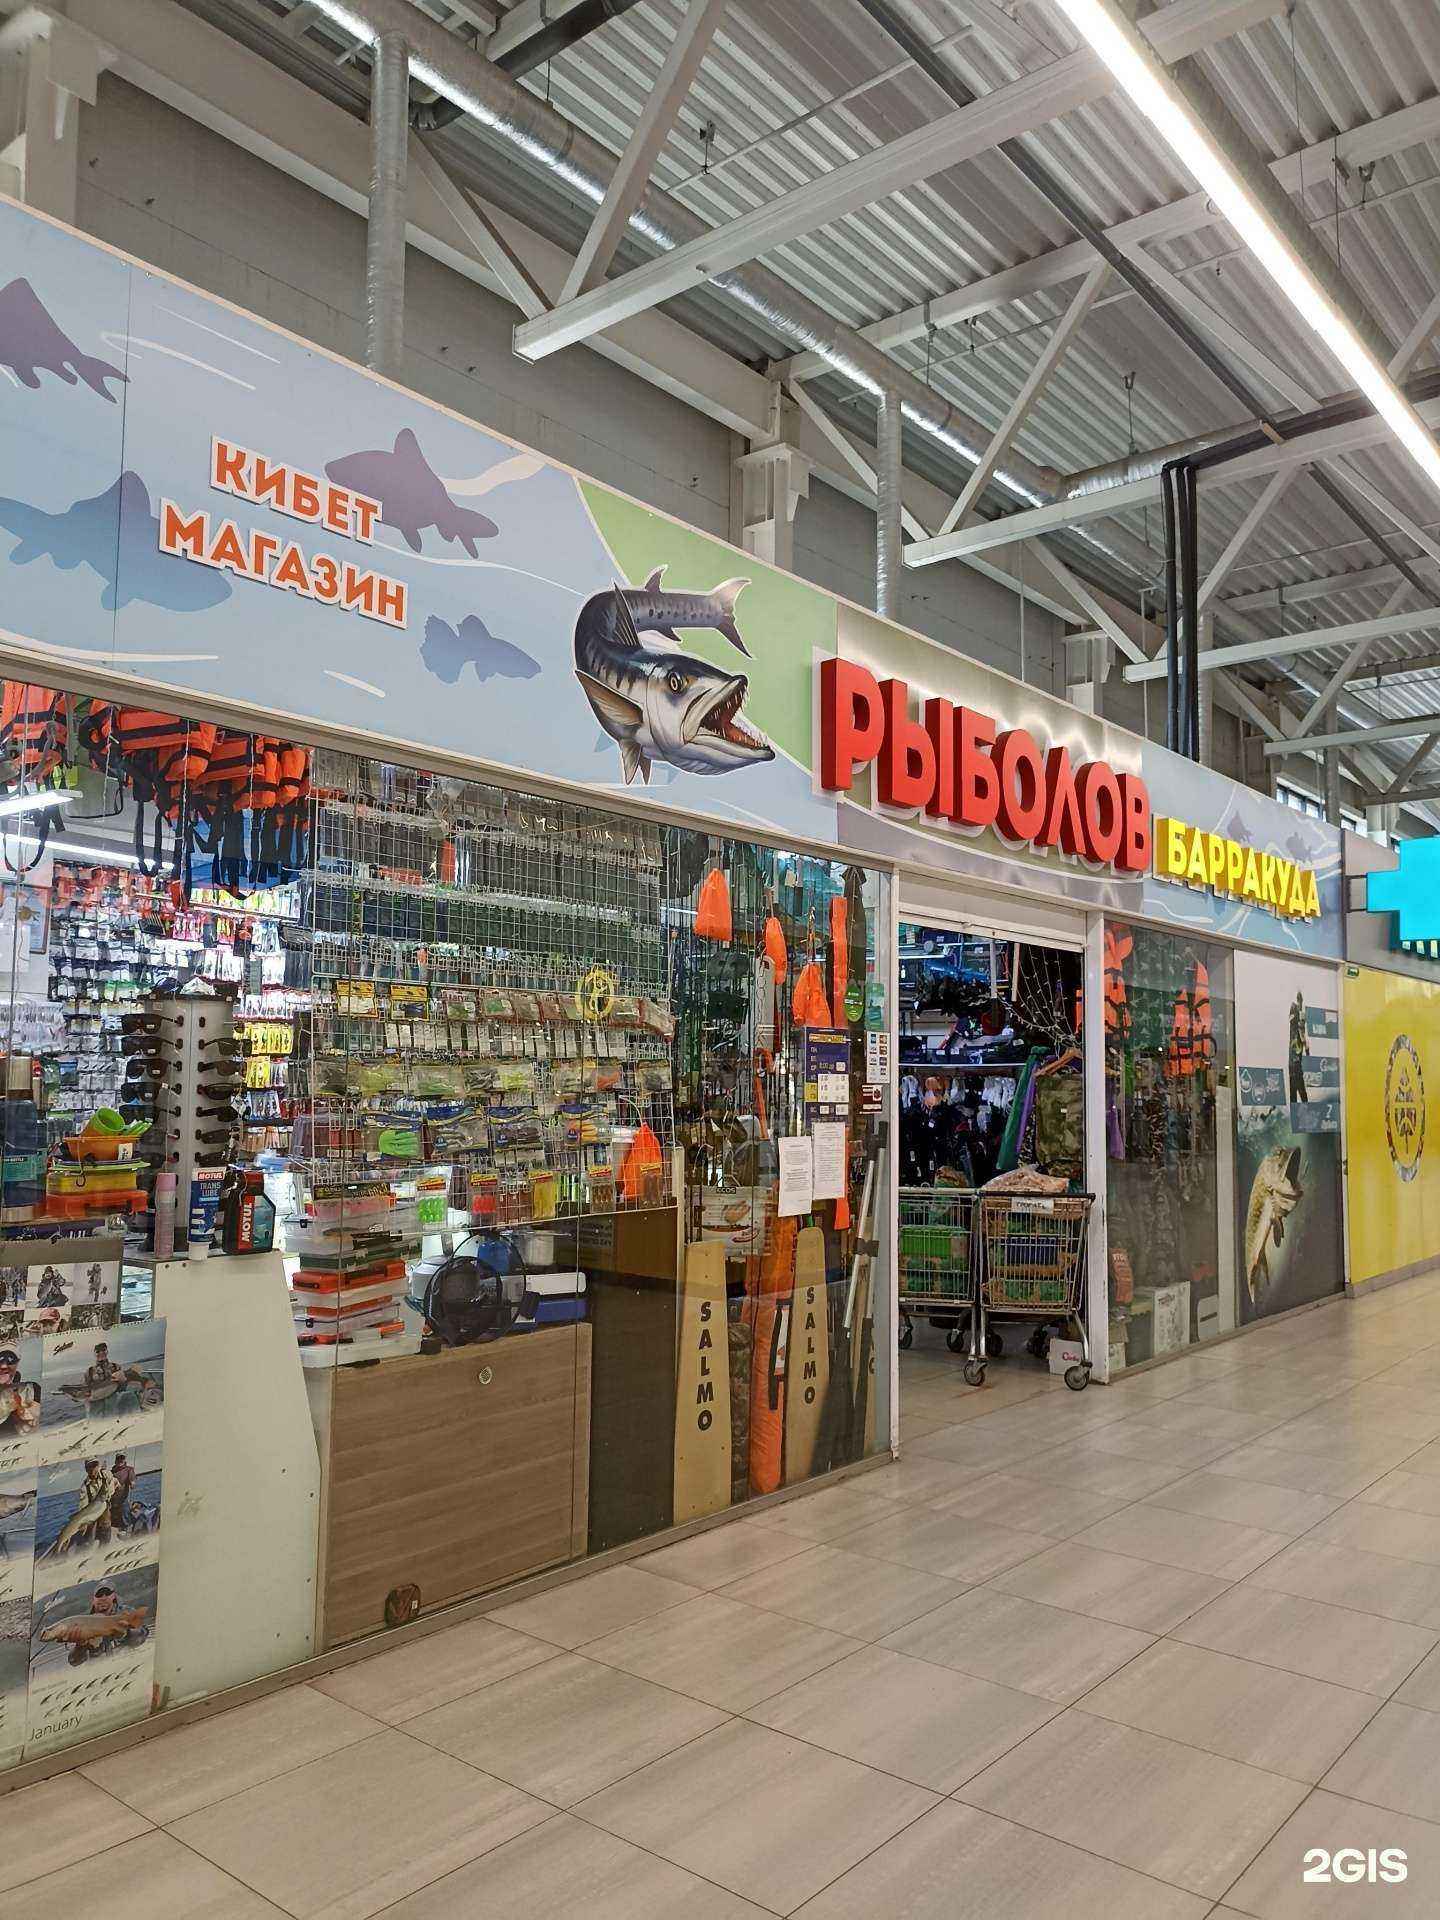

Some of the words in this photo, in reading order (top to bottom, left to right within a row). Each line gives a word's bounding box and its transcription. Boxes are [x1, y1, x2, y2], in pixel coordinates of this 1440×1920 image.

[212, 437, 381, 543] КИБЕТ
[161, 499, 407, 627] МАГАЗИН
[820, 657, 1151, 872] РЫБОЛОВ
[1156, 816, 1321, 919] БАРРАКУДА
[242, 1202, 253, 1243] MOTUL
[696, 1301, 715, 1432] SALMO
[804, 1286, 818, 1405] SALMO
[29, 1714, 83, 1742] January
